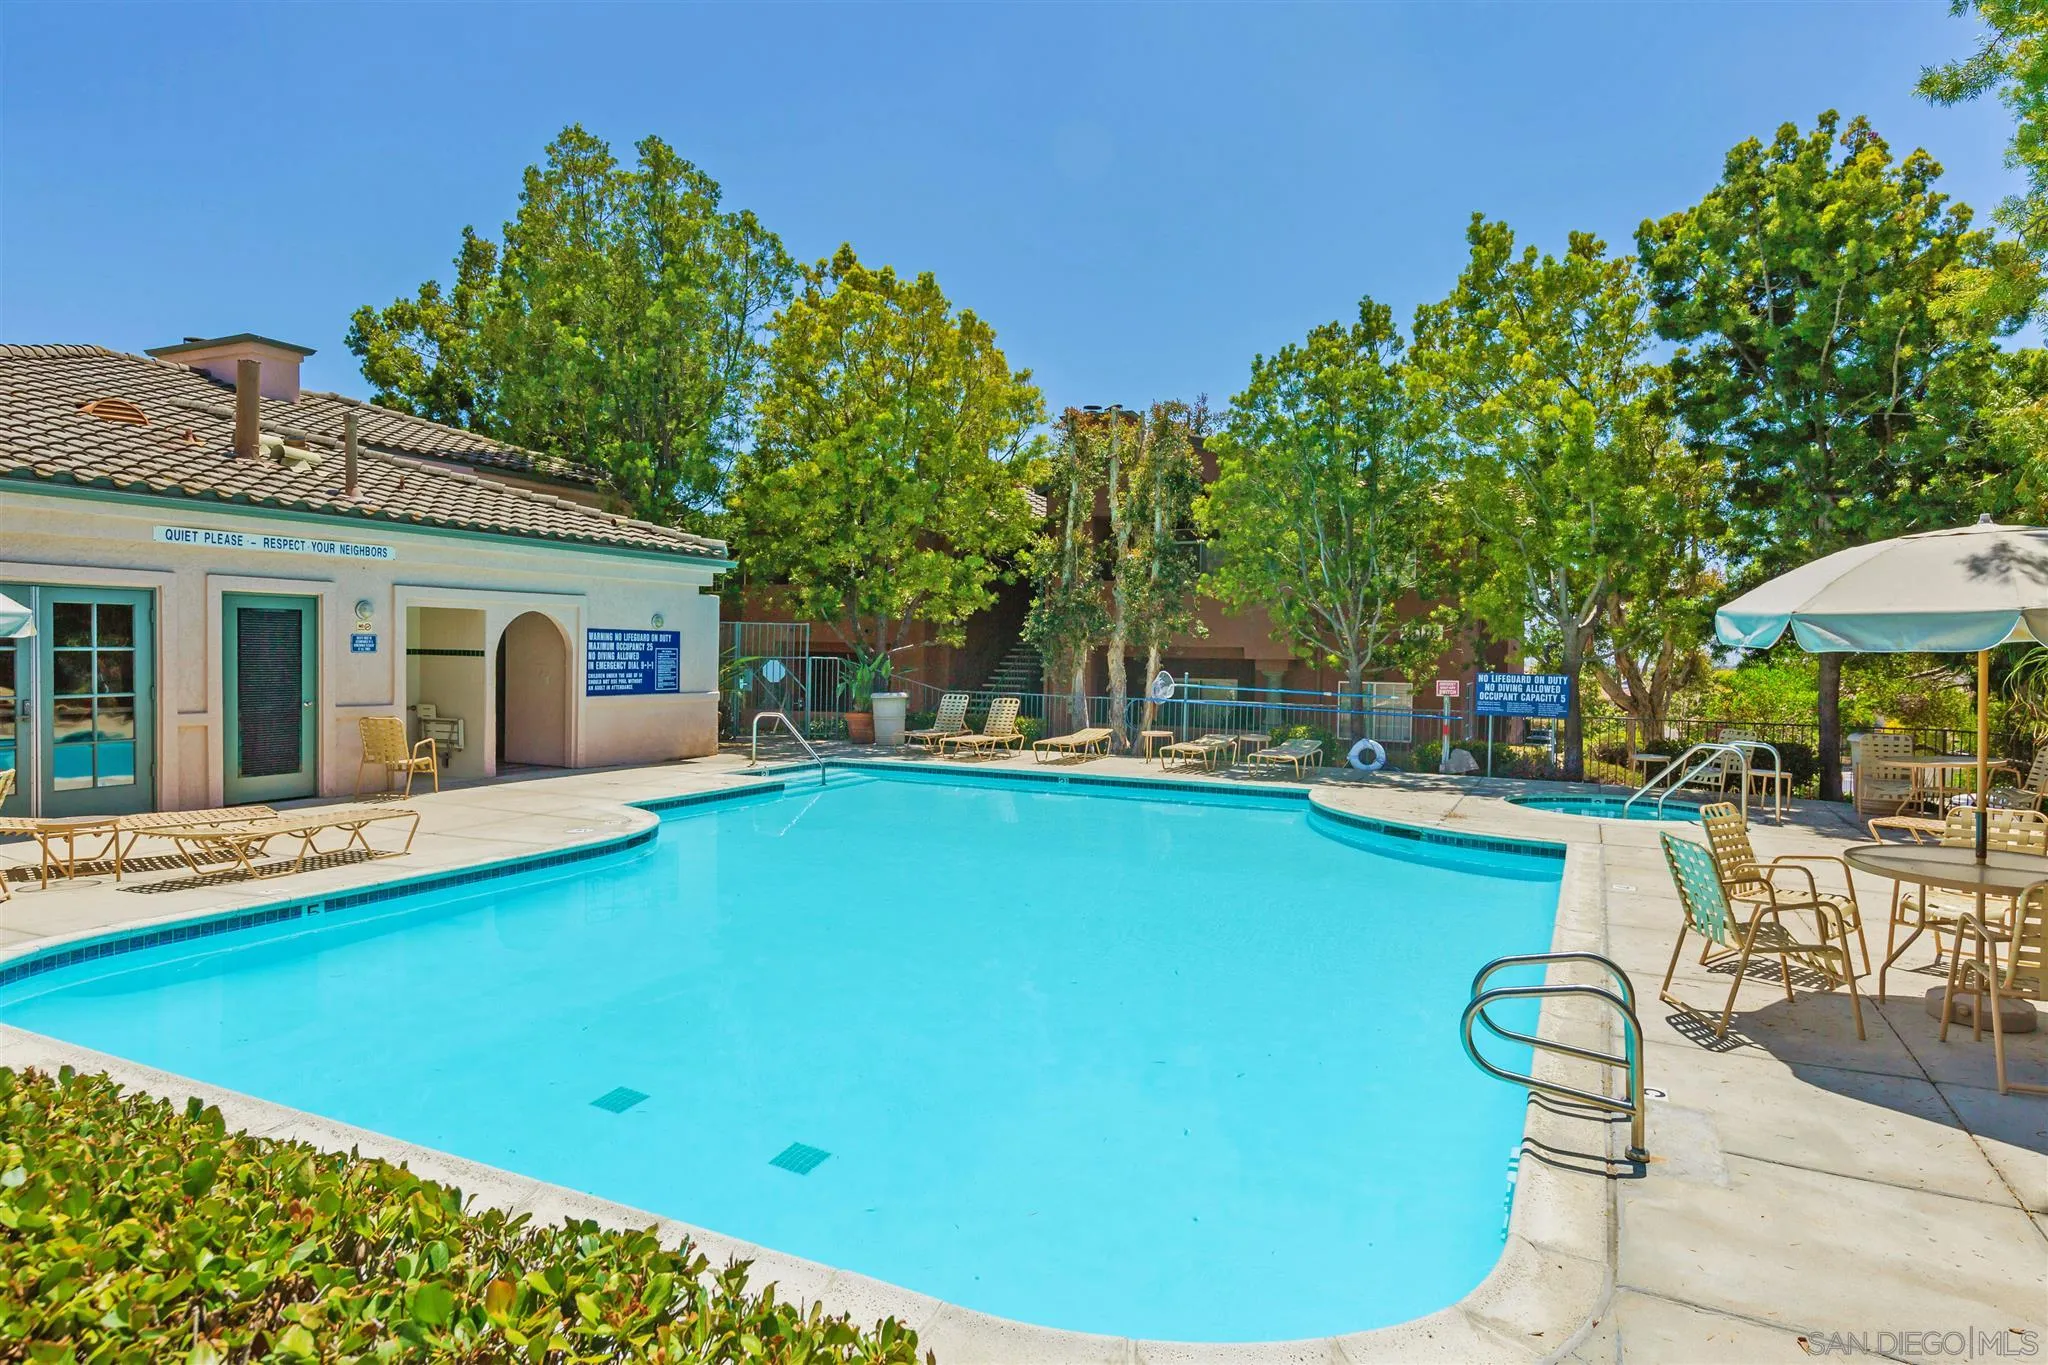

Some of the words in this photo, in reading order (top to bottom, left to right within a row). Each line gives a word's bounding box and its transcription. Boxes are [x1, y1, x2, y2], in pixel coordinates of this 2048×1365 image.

[165, 529, 198, 542] QUIET
[204, 533, 243, 546] PLEASE
[264, 538, 305, 551] RESPECT
[311, 542, 335, 554] YOUR
[340, 544, 388, 558] NEIGHBORS
[588, 632, 613, 641] WARNING
[614, 632, 622, 641] NO
[624, 633, 650, 642] LIFEGUARD
[651, 634, 658, 642] ON
[660, 634, 672, 642] DUTY
[588, 642, 614, 650] MAXIMUM
[616, 642, 645, 651] OCCUPANCY
[646, 643, 653, 651] 25
[588, 652, 596, 660] NO
[598, 652, 615, 660] DIVING
[617, 652, 639, 660] ALLOWED
[588, 661, 594, 670] IN
[596, 661, 626, 670] EMERGENCY
[628, 661, 639, 669] DIAL
[1478, 674, 1488, 683] NO
[1491, 675, 1531, 684] LIFEGUARD
[1534, 676, 1544, 684] ON
[1548, 676, 1568, 685] DUTY
[1484, 683, 1494, 692] NO
[1498, 684, 1523, 692] DIVING
[1526, 684, 1561, 694] ALLOWED
[1480, 692, 1517, 701] OCCUPANT
[1520, 693, 1558, 703] CAPACITY
[1560, 695, 1566, 703] 5
